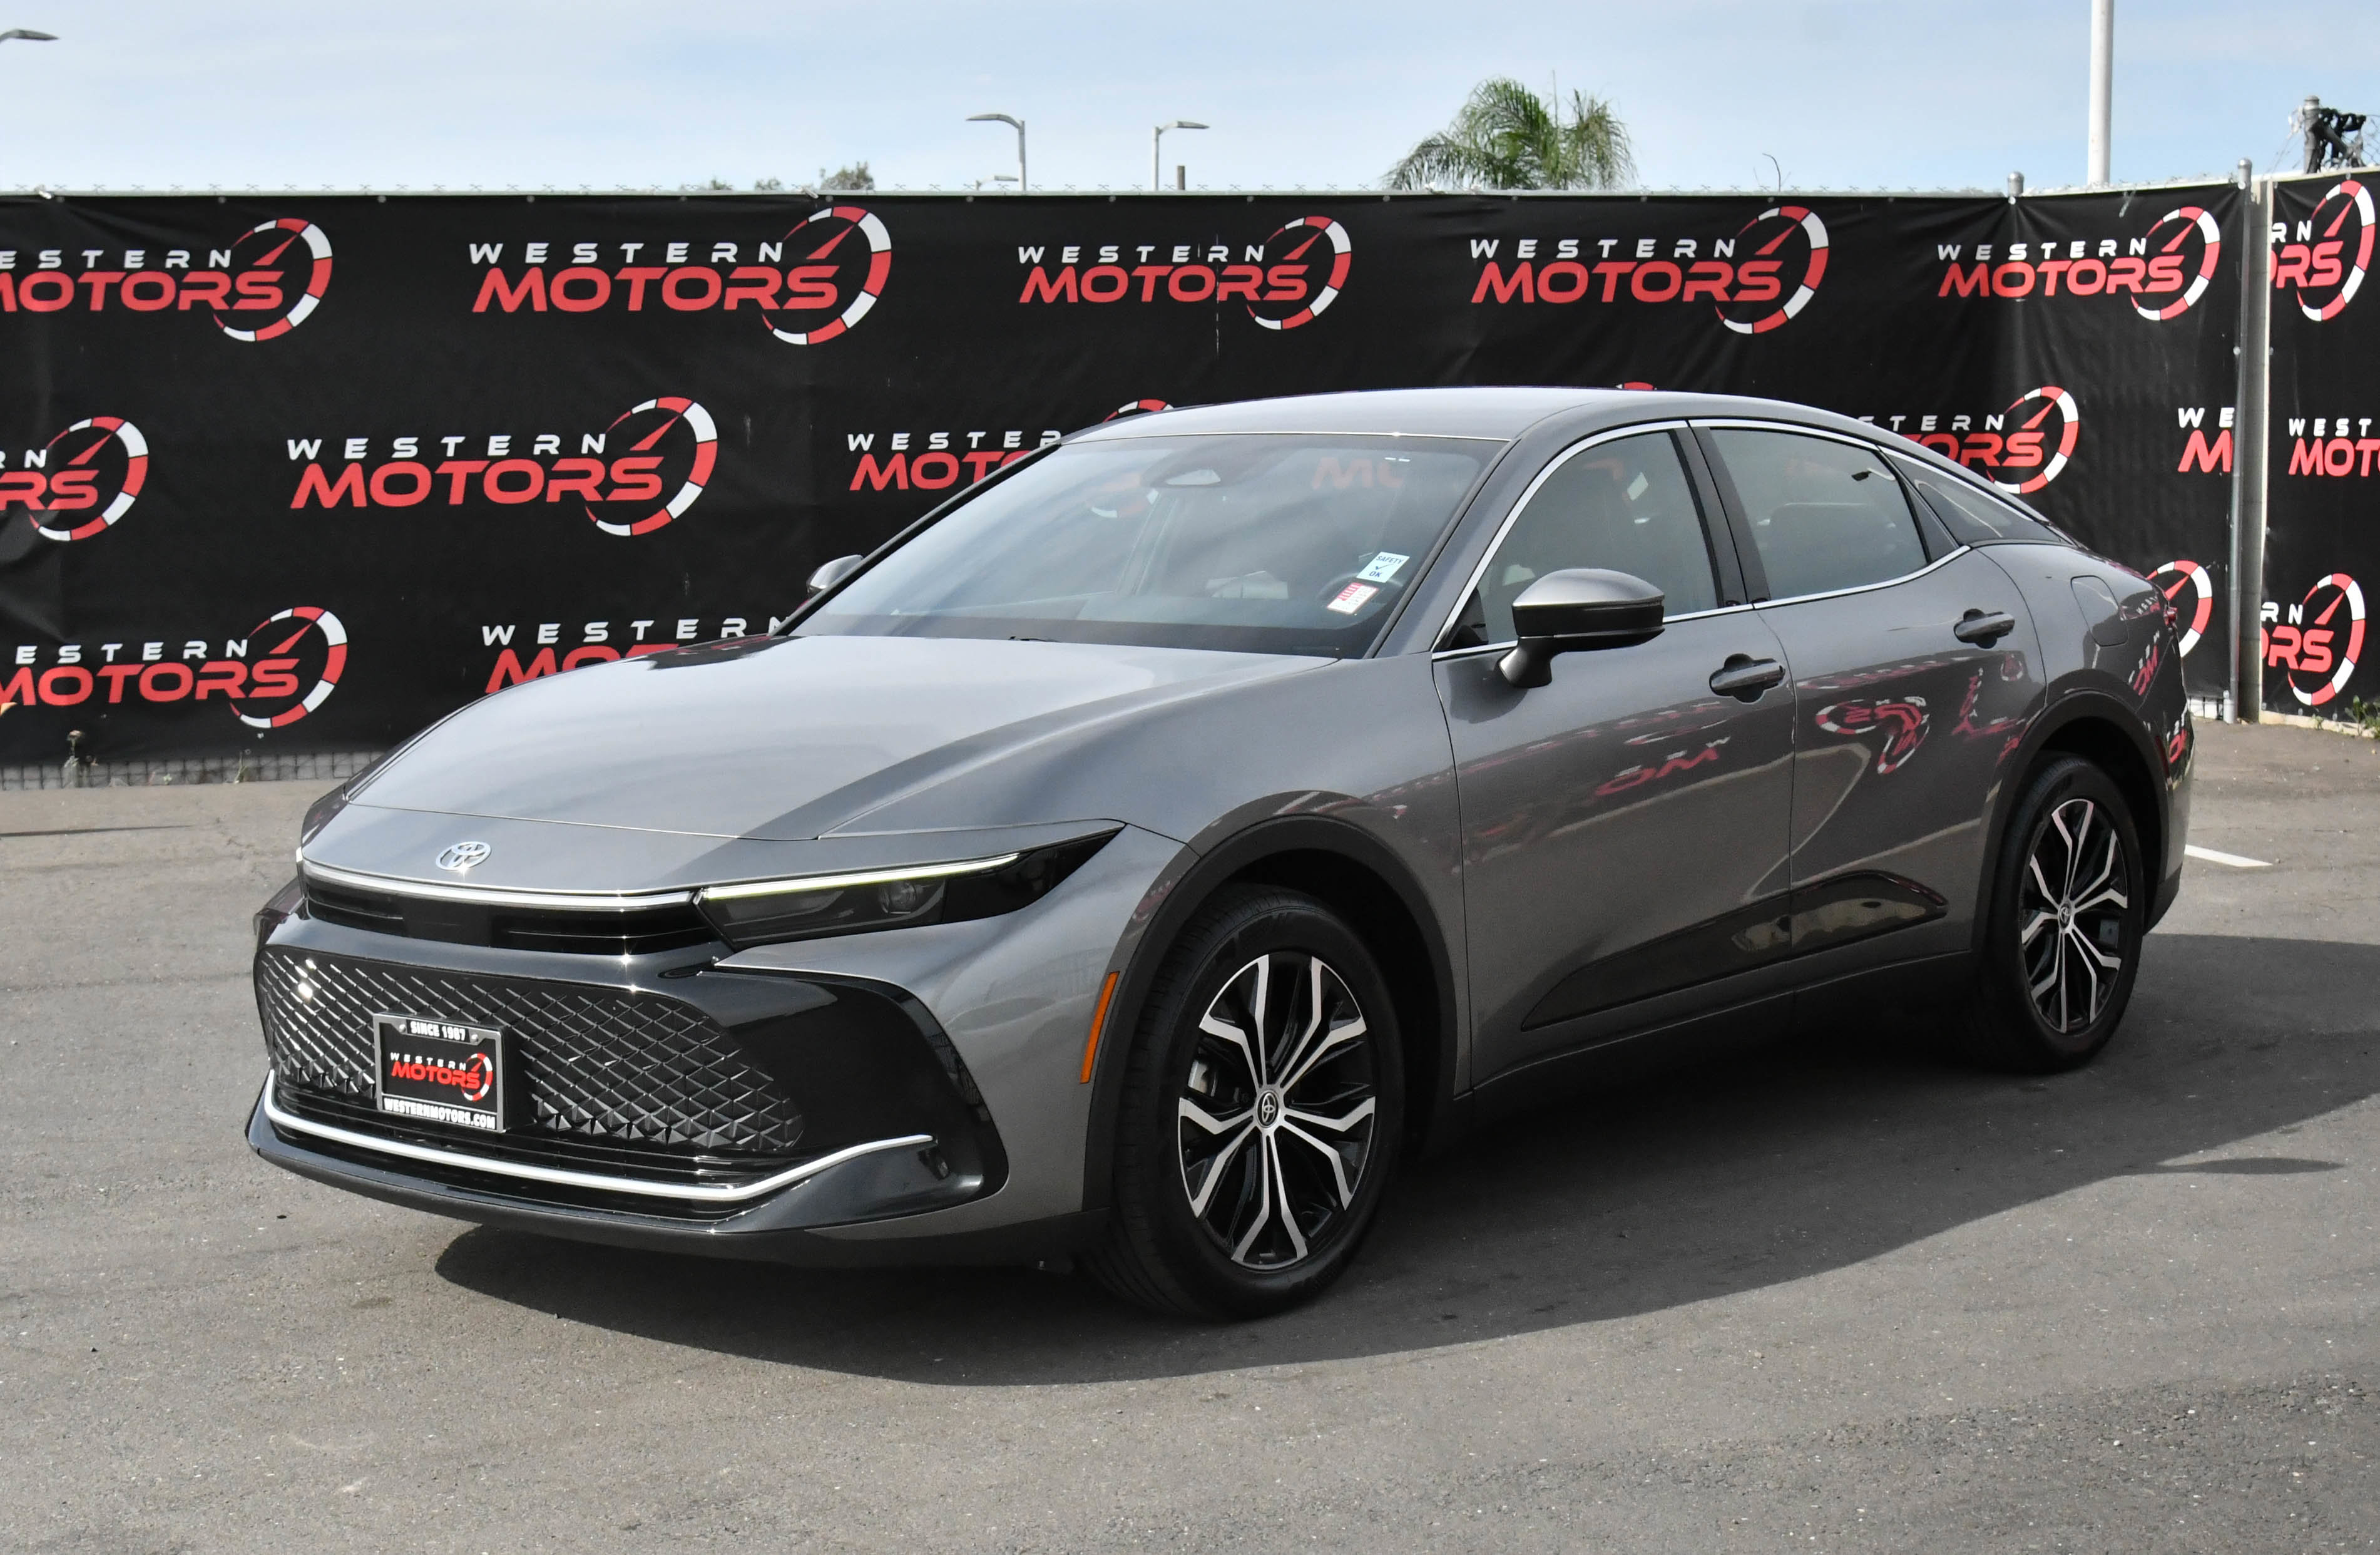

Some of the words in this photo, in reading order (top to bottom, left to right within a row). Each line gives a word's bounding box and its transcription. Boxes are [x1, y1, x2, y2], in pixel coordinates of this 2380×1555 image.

[0, 250, 230, 269] ESTERN
[469, 242, 783, 264] WESTERN
[1018, 245, 1264, 264] WESTERN
[1471, 239, 1735, 259] WESTERN
[1938, 237, 2147, 261] WESTERN
[472, 265, 839, 312] MOTORS
[1019, 264, 1309, 304] MOTORS
[1471, 260, 1783, 303] MOTORS
[1938, 255, 2185, 297] MOTORS
[0, 271, 284, 312] OTORS
[847, 430, 1061, 451] WESTER
[2289, 418, 2372, 437] WEST
[287, 433, 606, 460] WESTERN
[2288, 438, 2380, 477] MOT
[290, 456, 665, 508] MOTORS
[849, 450, 1033, 491] MOT
[15, 640, 248, 664] ESTERN
[411, 1021, 440, 1037] SINCE
[390, 1052, 466, 1071] WESTERN
[392, 1061, 480, 1089] MOTORS
[384, 1098, 495, 1129] WESTERNMOTORS.COM
